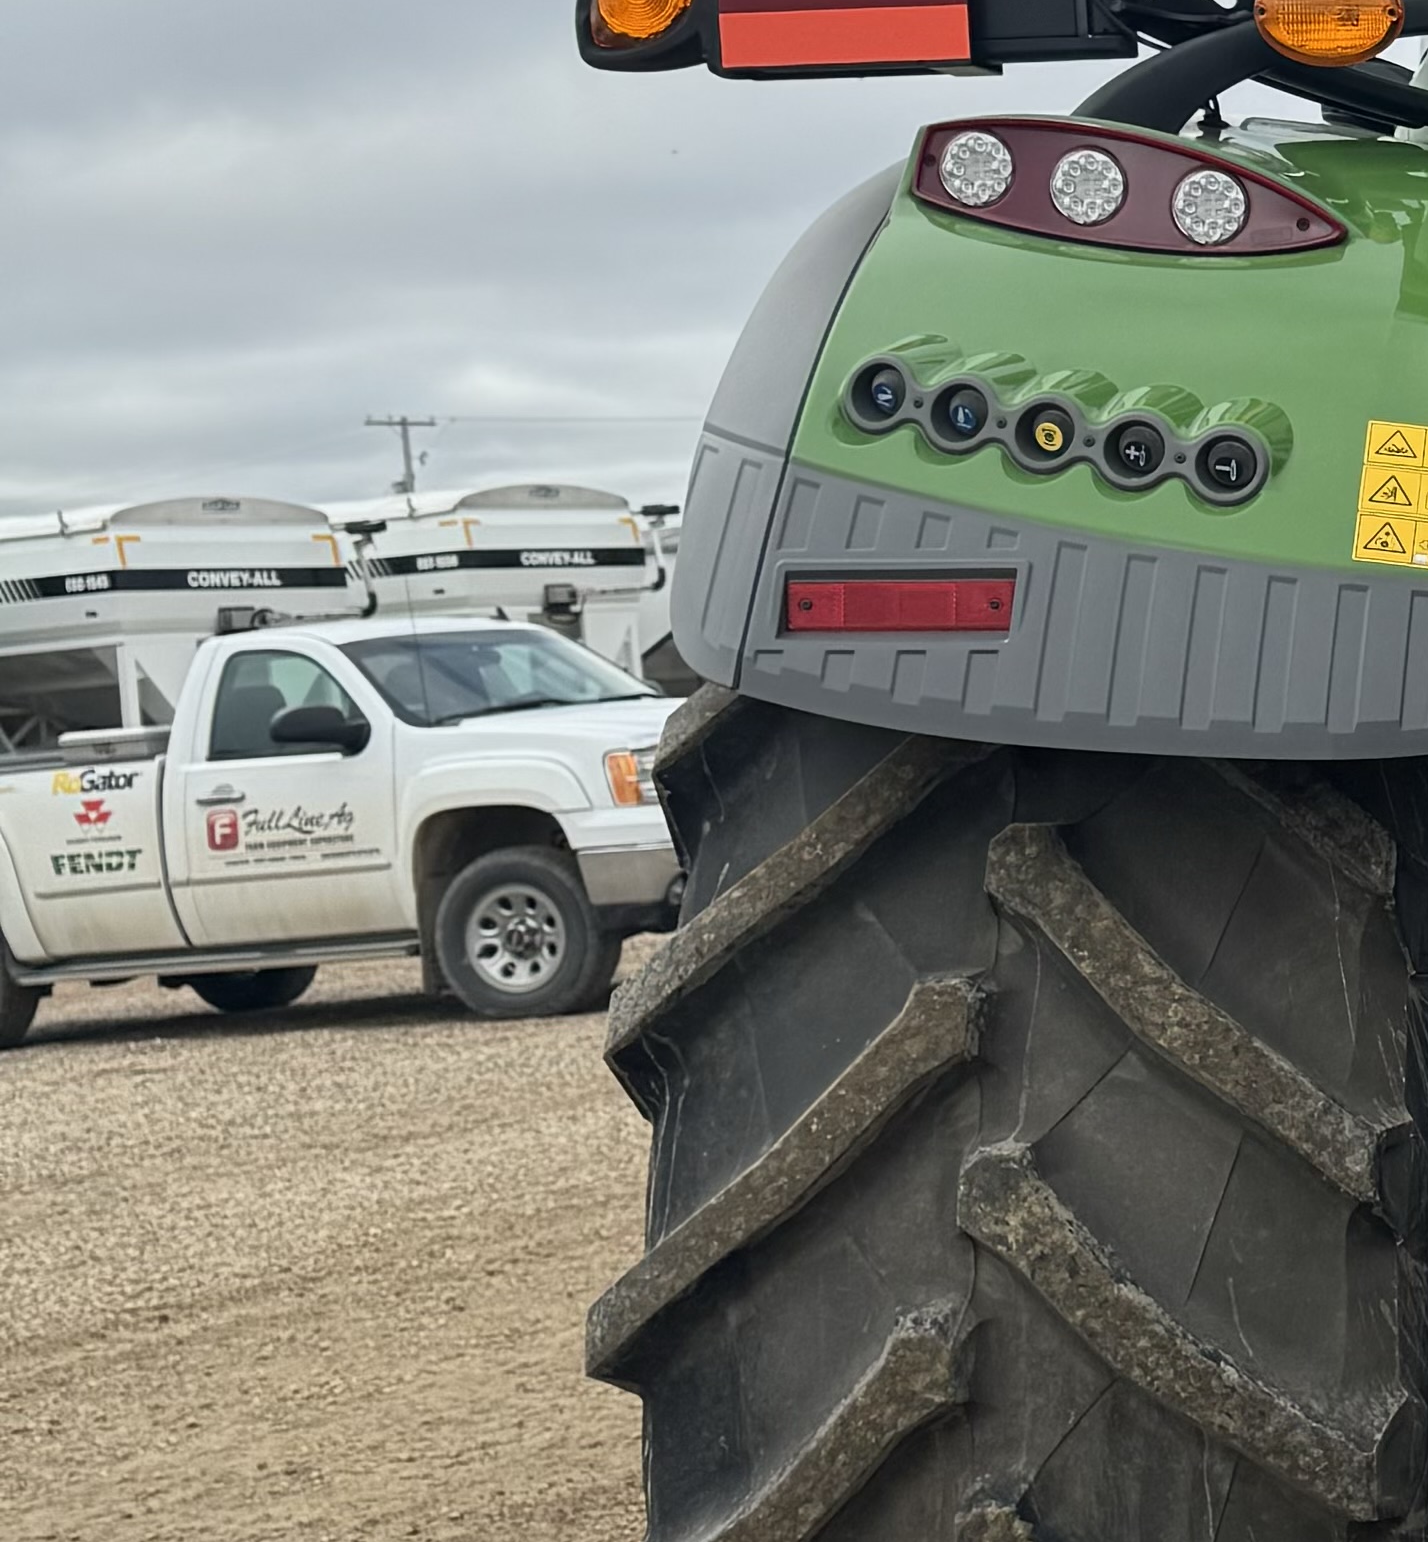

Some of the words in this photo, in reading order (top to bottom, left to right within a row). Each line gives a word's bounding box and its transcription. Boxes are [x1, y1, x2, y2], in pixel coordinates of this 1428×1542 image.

[520, 552, 595, 566] CONVEY-ALL
[187, 571, 281, 587] CONVEY-ALL
[52, 769, 139, 795] RoGator
[50, 848, 142, 875] FENDT
